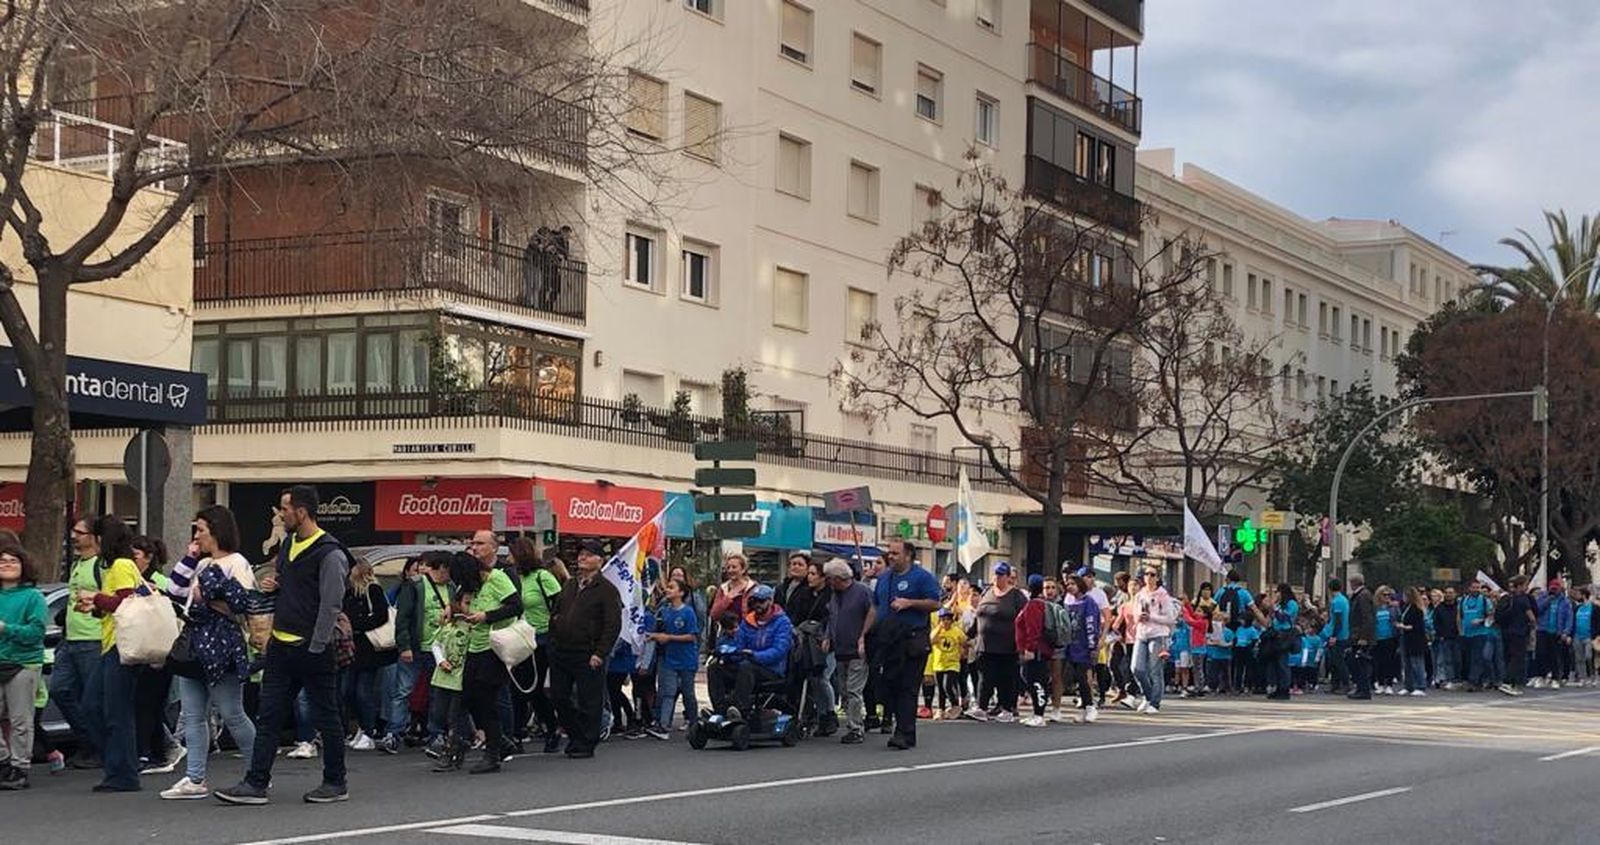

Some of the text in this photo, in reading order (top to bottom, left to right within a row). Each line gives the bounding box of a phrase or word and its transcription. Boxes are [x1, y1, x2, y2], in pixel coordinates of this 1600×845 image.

[399, 494, 438, 514] Foot
[438, 496, 460, 514] on
[570, 497, 642, 522] Foot on Mars
